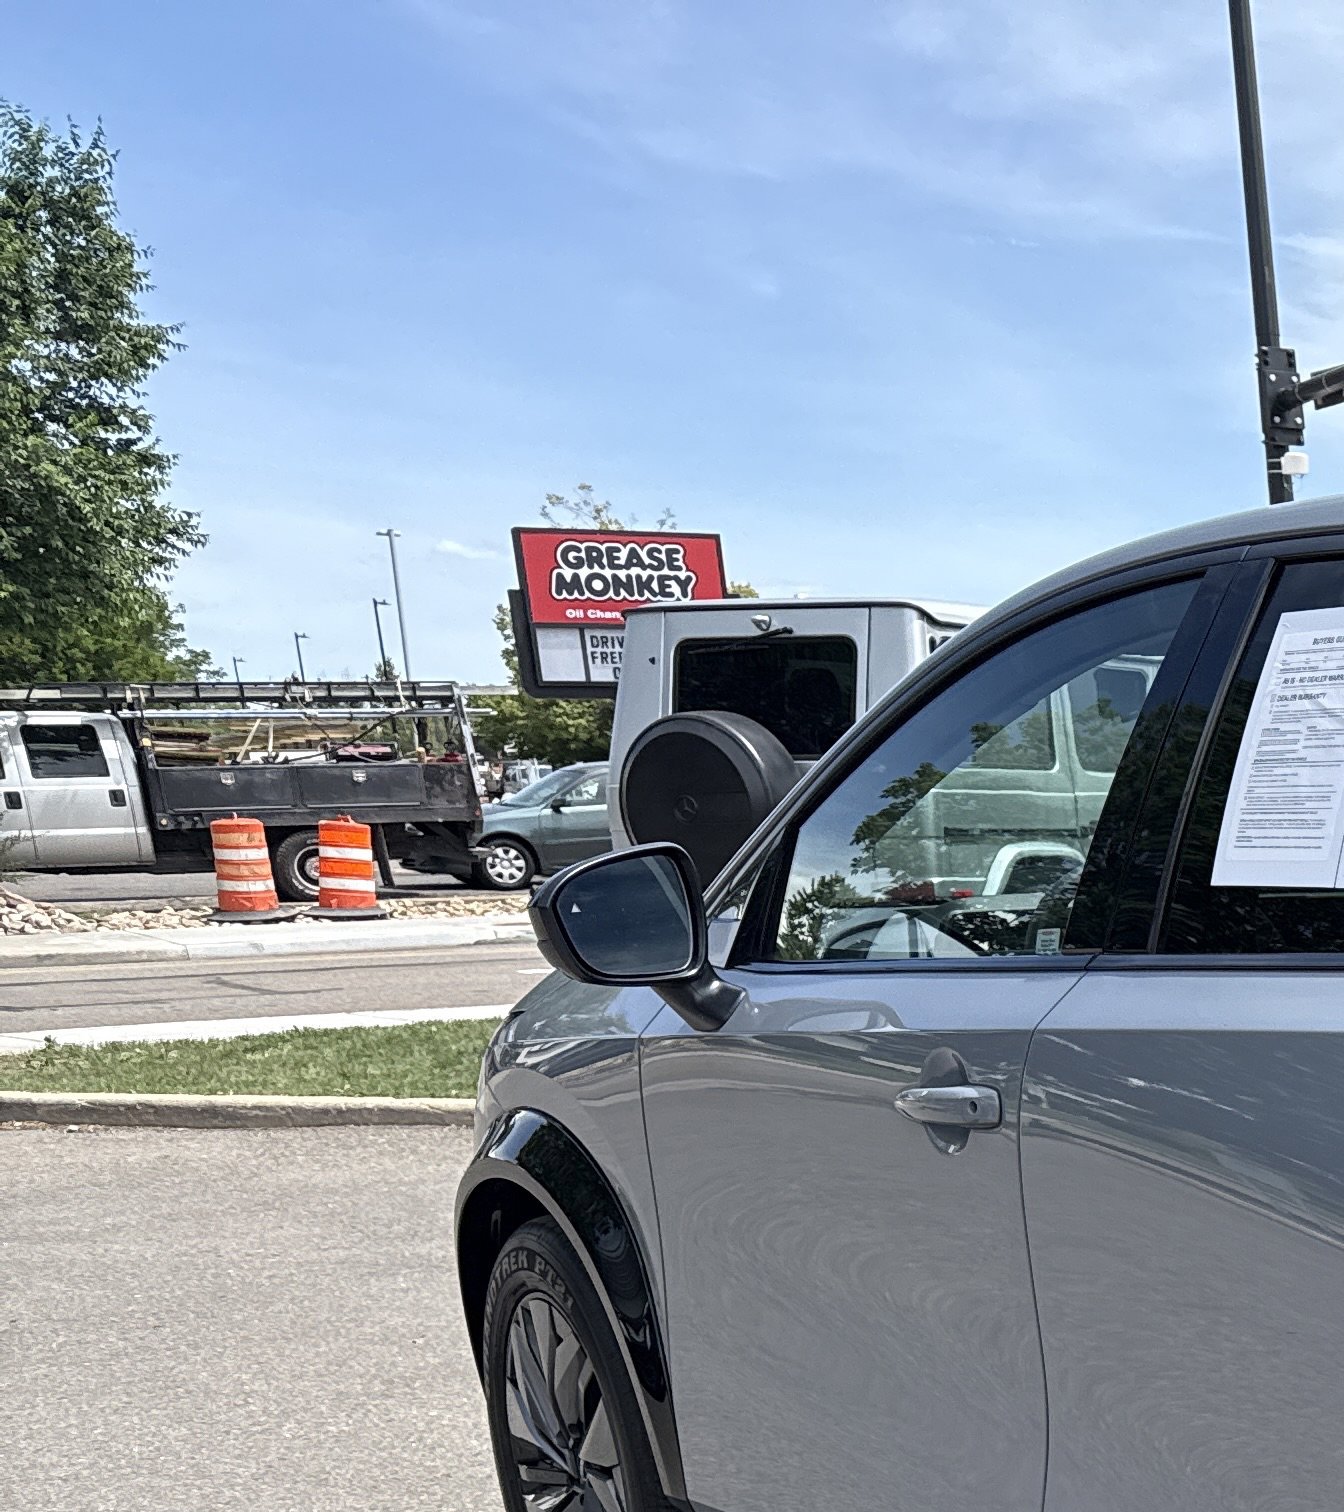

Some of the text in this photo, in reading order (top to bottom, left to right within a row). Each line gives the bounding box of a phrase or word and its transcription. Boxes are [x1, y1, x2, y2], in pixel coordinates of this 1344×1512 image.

[559, 543, 684, 572] GREASE
[553, 572, 694, 599] MONKEY
[565, 609, 625, 622] Oil Chan
